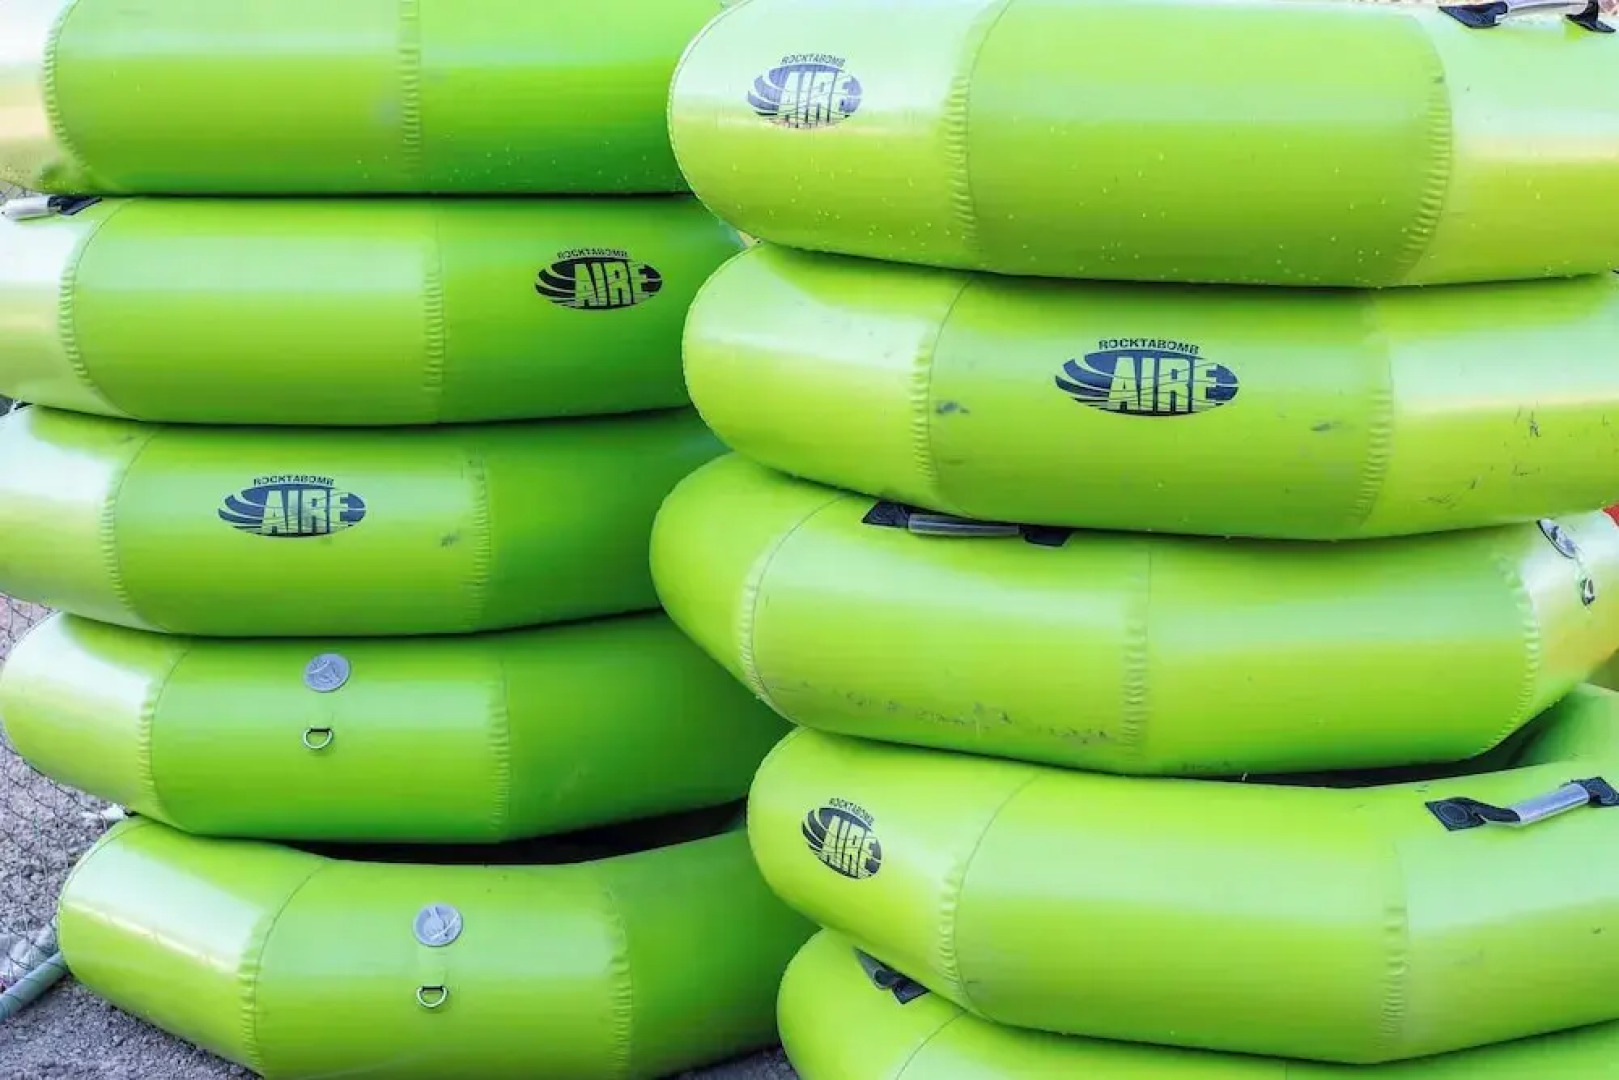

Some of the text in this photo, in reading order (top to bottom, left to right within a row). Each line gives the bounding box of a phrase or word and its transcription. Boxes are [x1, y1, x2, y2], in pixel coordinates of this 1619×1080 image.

[777, 70, 852, 127] AIRE
[573, 261, 649, 307] AIRE
[1098, 337, 1200, 354] ROCKTABOMB
[1108, 356, 1218, 412] AIRE
[253, 475, 335, 487] ROCKTABOMB
[261, 488, 350, 535] AIRE
[820, 815, 879, 878] AIRE
